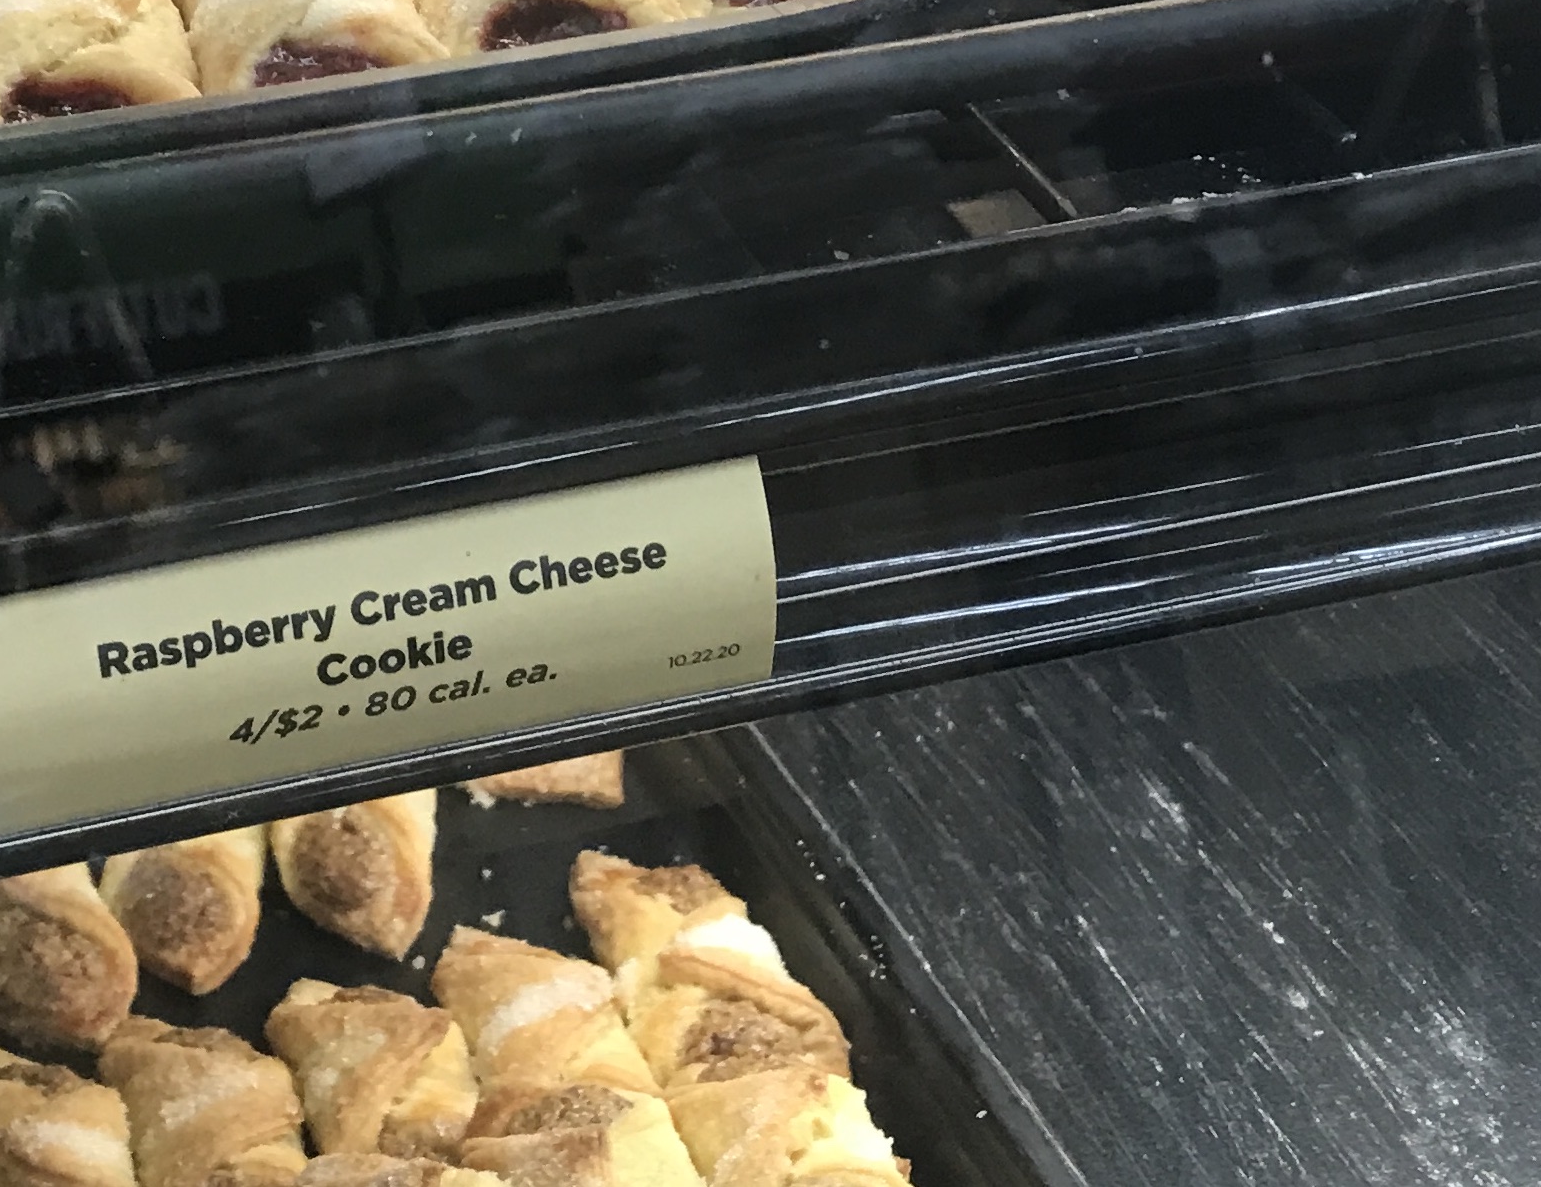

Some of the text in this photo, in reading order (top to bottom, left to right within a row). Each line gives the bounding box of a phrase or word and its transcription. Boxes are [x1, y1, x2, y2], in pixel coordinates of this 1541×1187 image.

[96, 542, 668, 679] Raspberry Cream Cheese
[316, 630, 473, 687] Cookie
[667, 642, 743, 670] 10.22.20
[228, 662, 558, 747] 4/$2 80 cal. ea.
